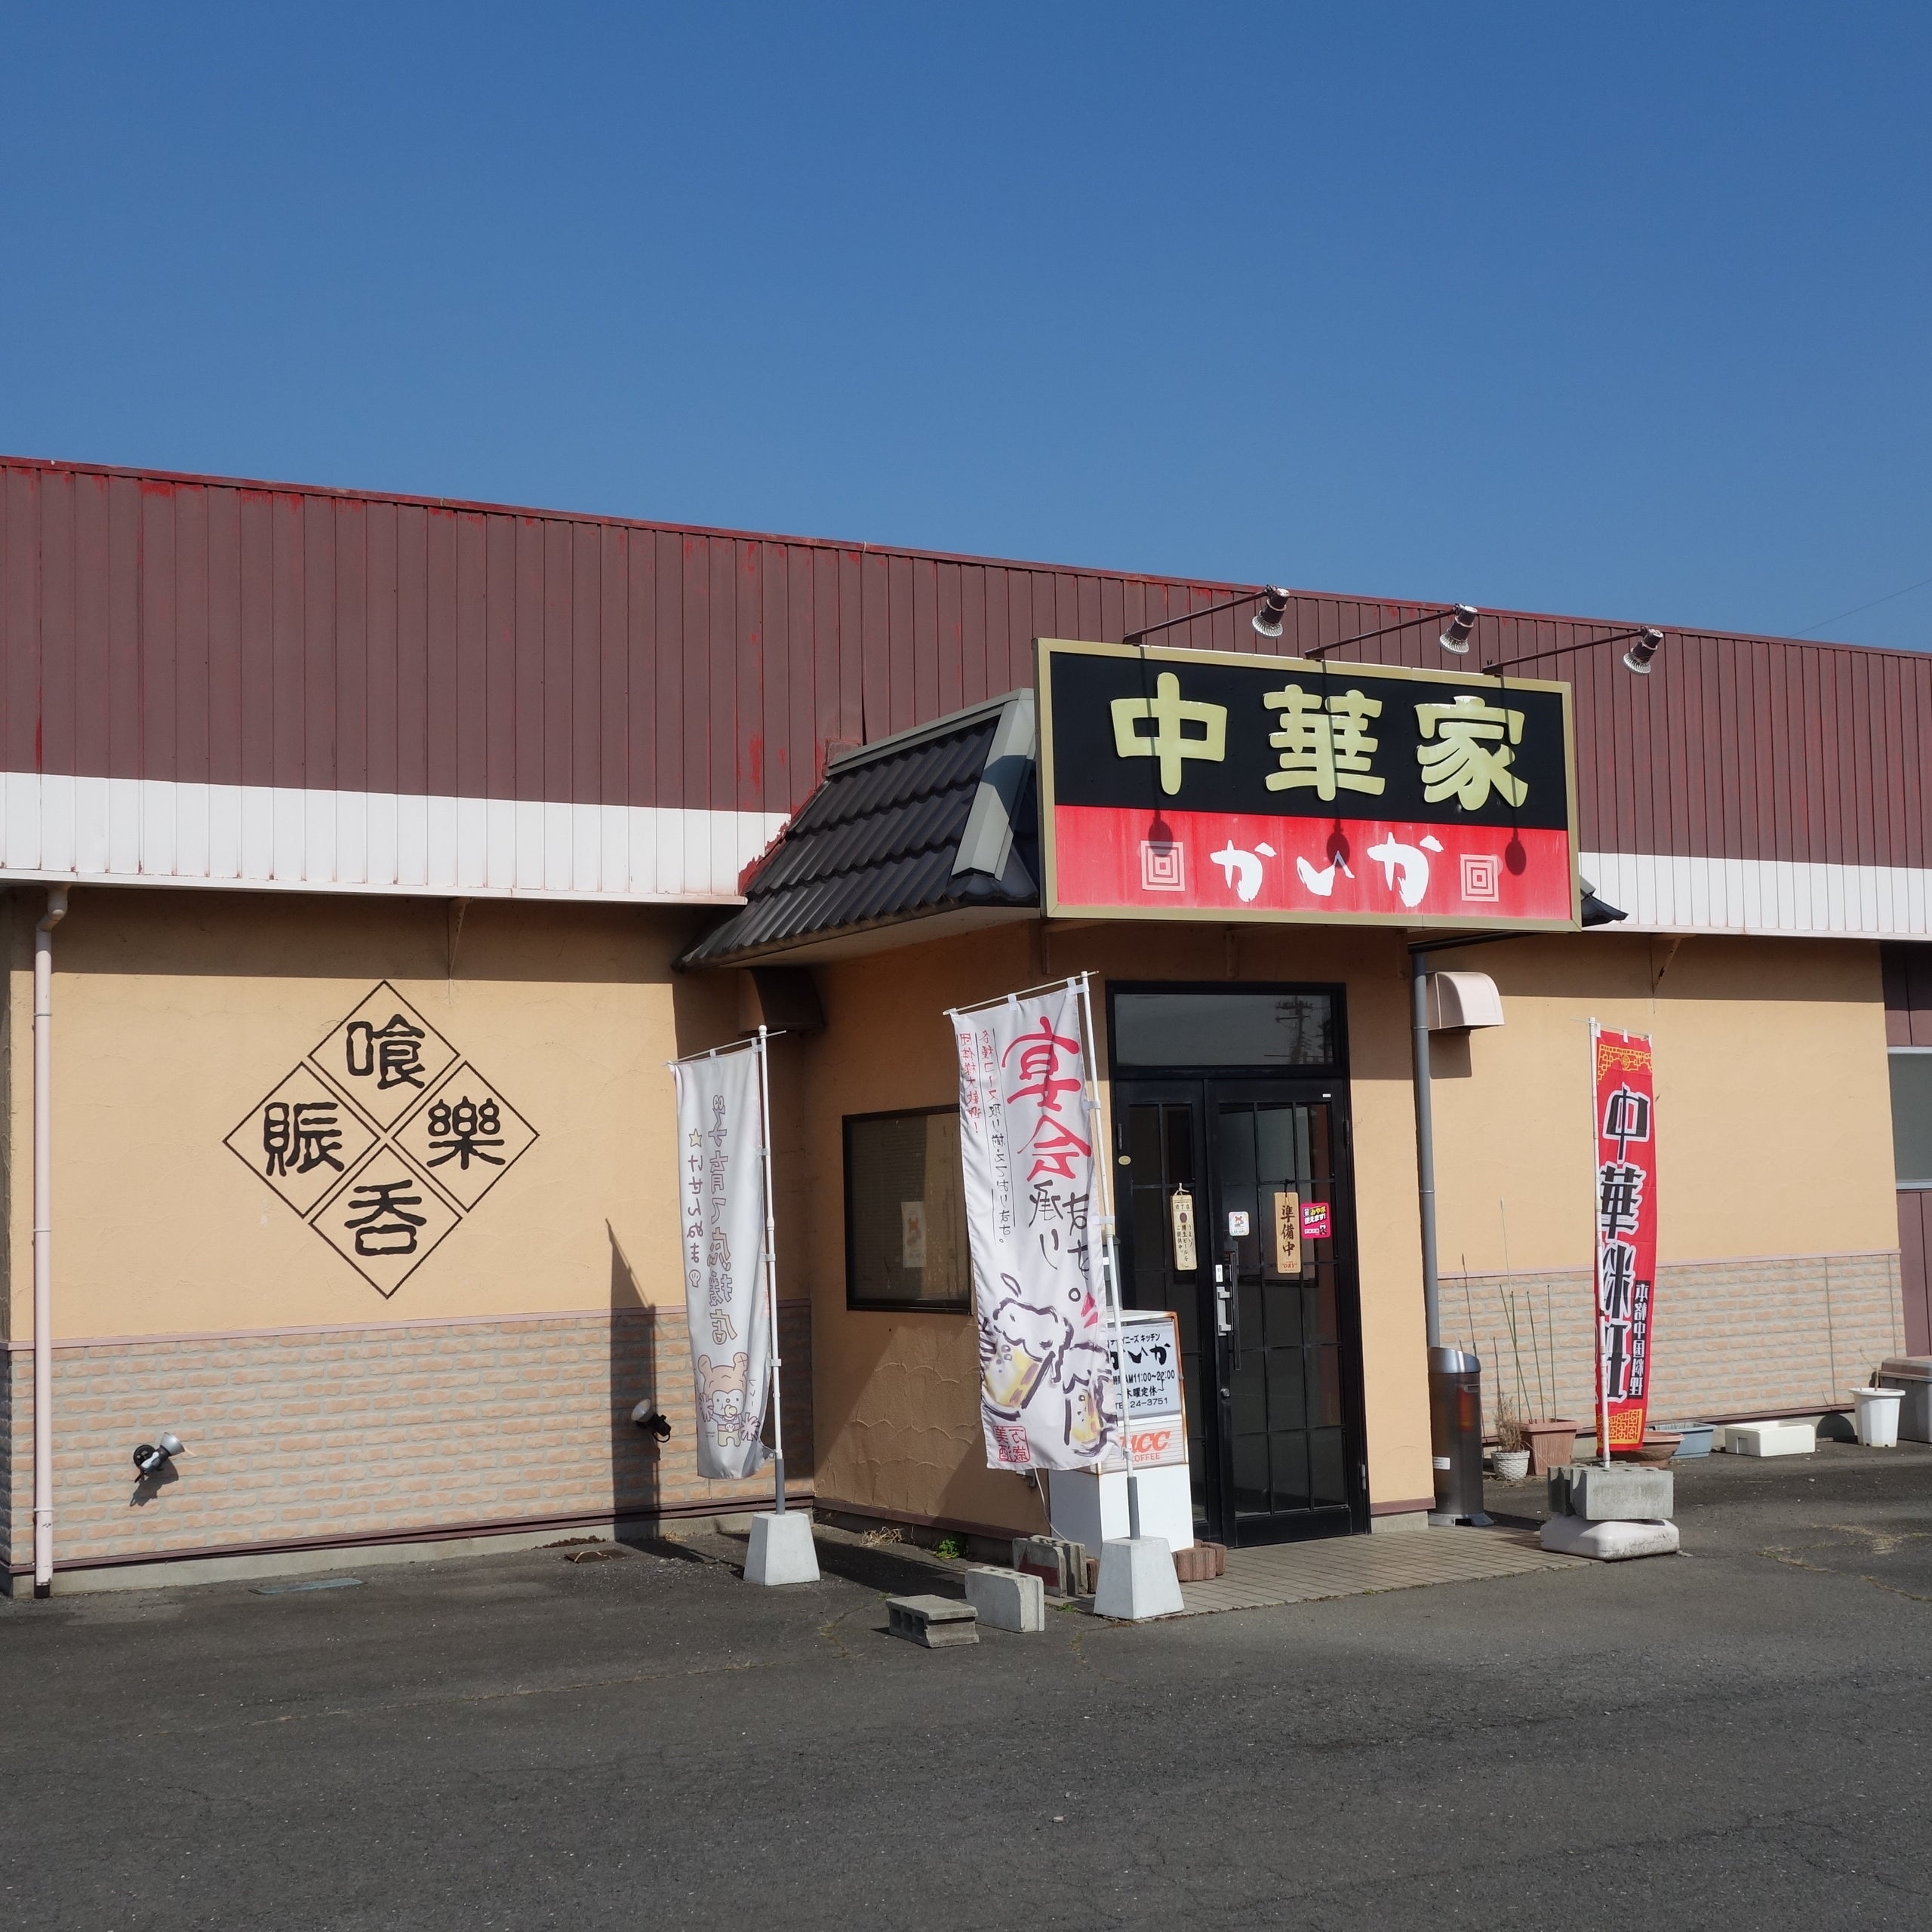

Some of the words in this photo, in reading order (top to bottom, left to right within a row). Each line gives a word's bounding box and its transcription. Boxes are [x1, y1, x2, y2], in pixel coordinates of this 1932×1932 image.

[1110, 672, 1529, 811] 中華家
[346, 1014, 426, 1090] 喰
[1280, 1204, 1295, 1257] 準備中
[1130, 1397, 1168, 1408] 24-3751
[1132, 1453, 1160, 1463] OFFEE
